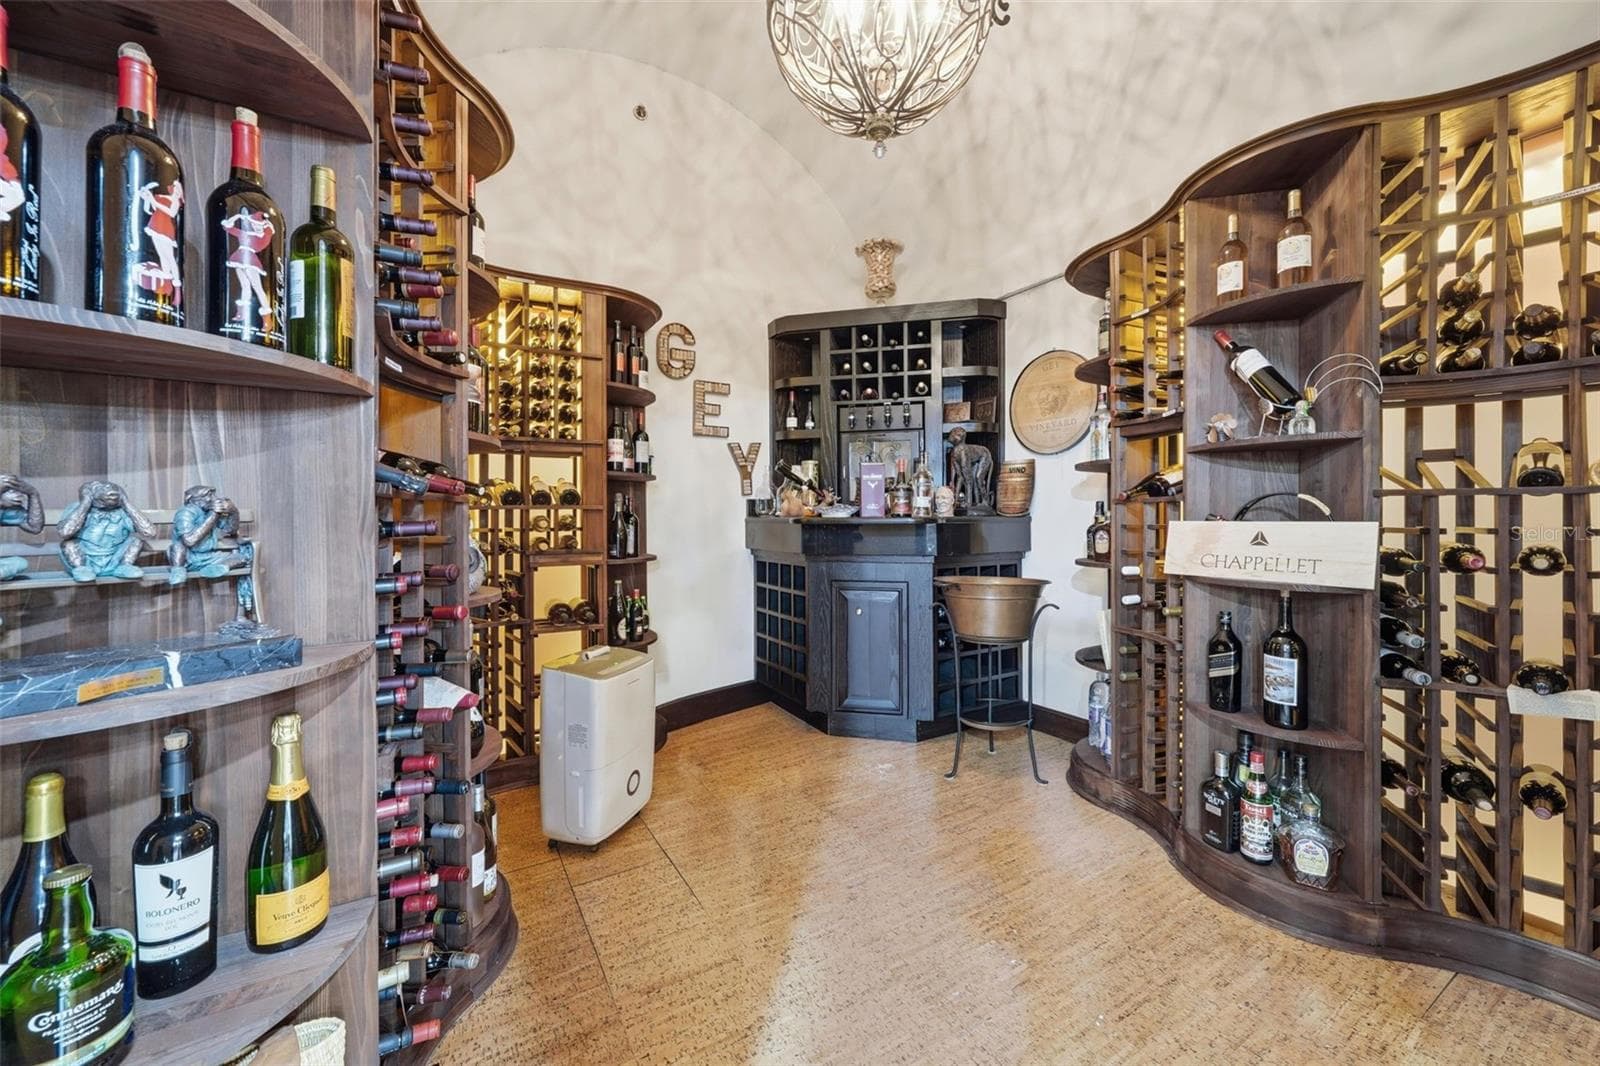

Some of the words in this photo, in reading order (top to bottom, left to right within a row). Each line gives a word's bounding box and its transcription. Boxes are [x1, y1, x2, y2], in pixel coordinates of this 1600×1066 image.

[1008, 466, 1026, 474] VINO
[1200, 553, 1322, 575] CHAPPELLET
[145, 898, 201, 918] BOLONERO
